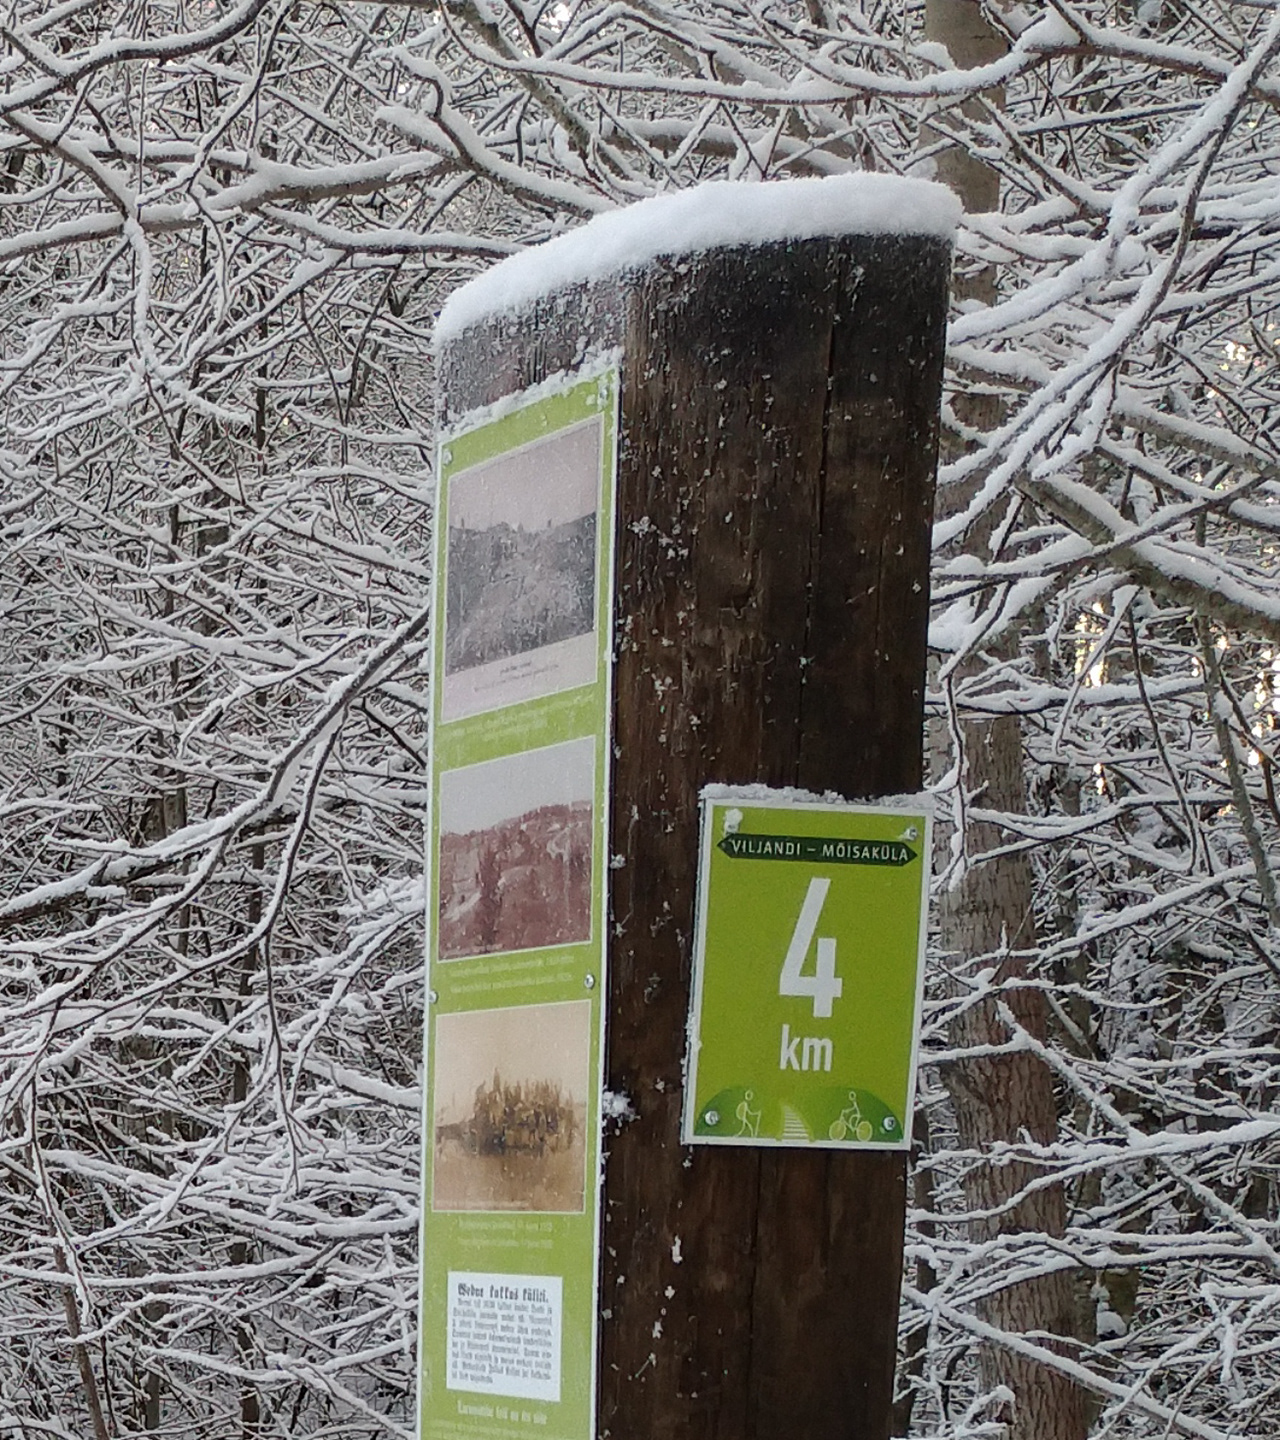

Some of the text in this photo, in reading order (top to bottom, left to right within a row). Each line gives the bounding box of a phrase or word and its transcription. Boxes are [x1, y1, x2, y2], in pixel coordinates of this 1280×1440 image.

[731, 839, 801, 856] VILJANDI
[822, 842, 909, 862] MÕISAKÜLA
[779, 877, 843, 1018] 4
[779, 1023, 833, 1072] km
